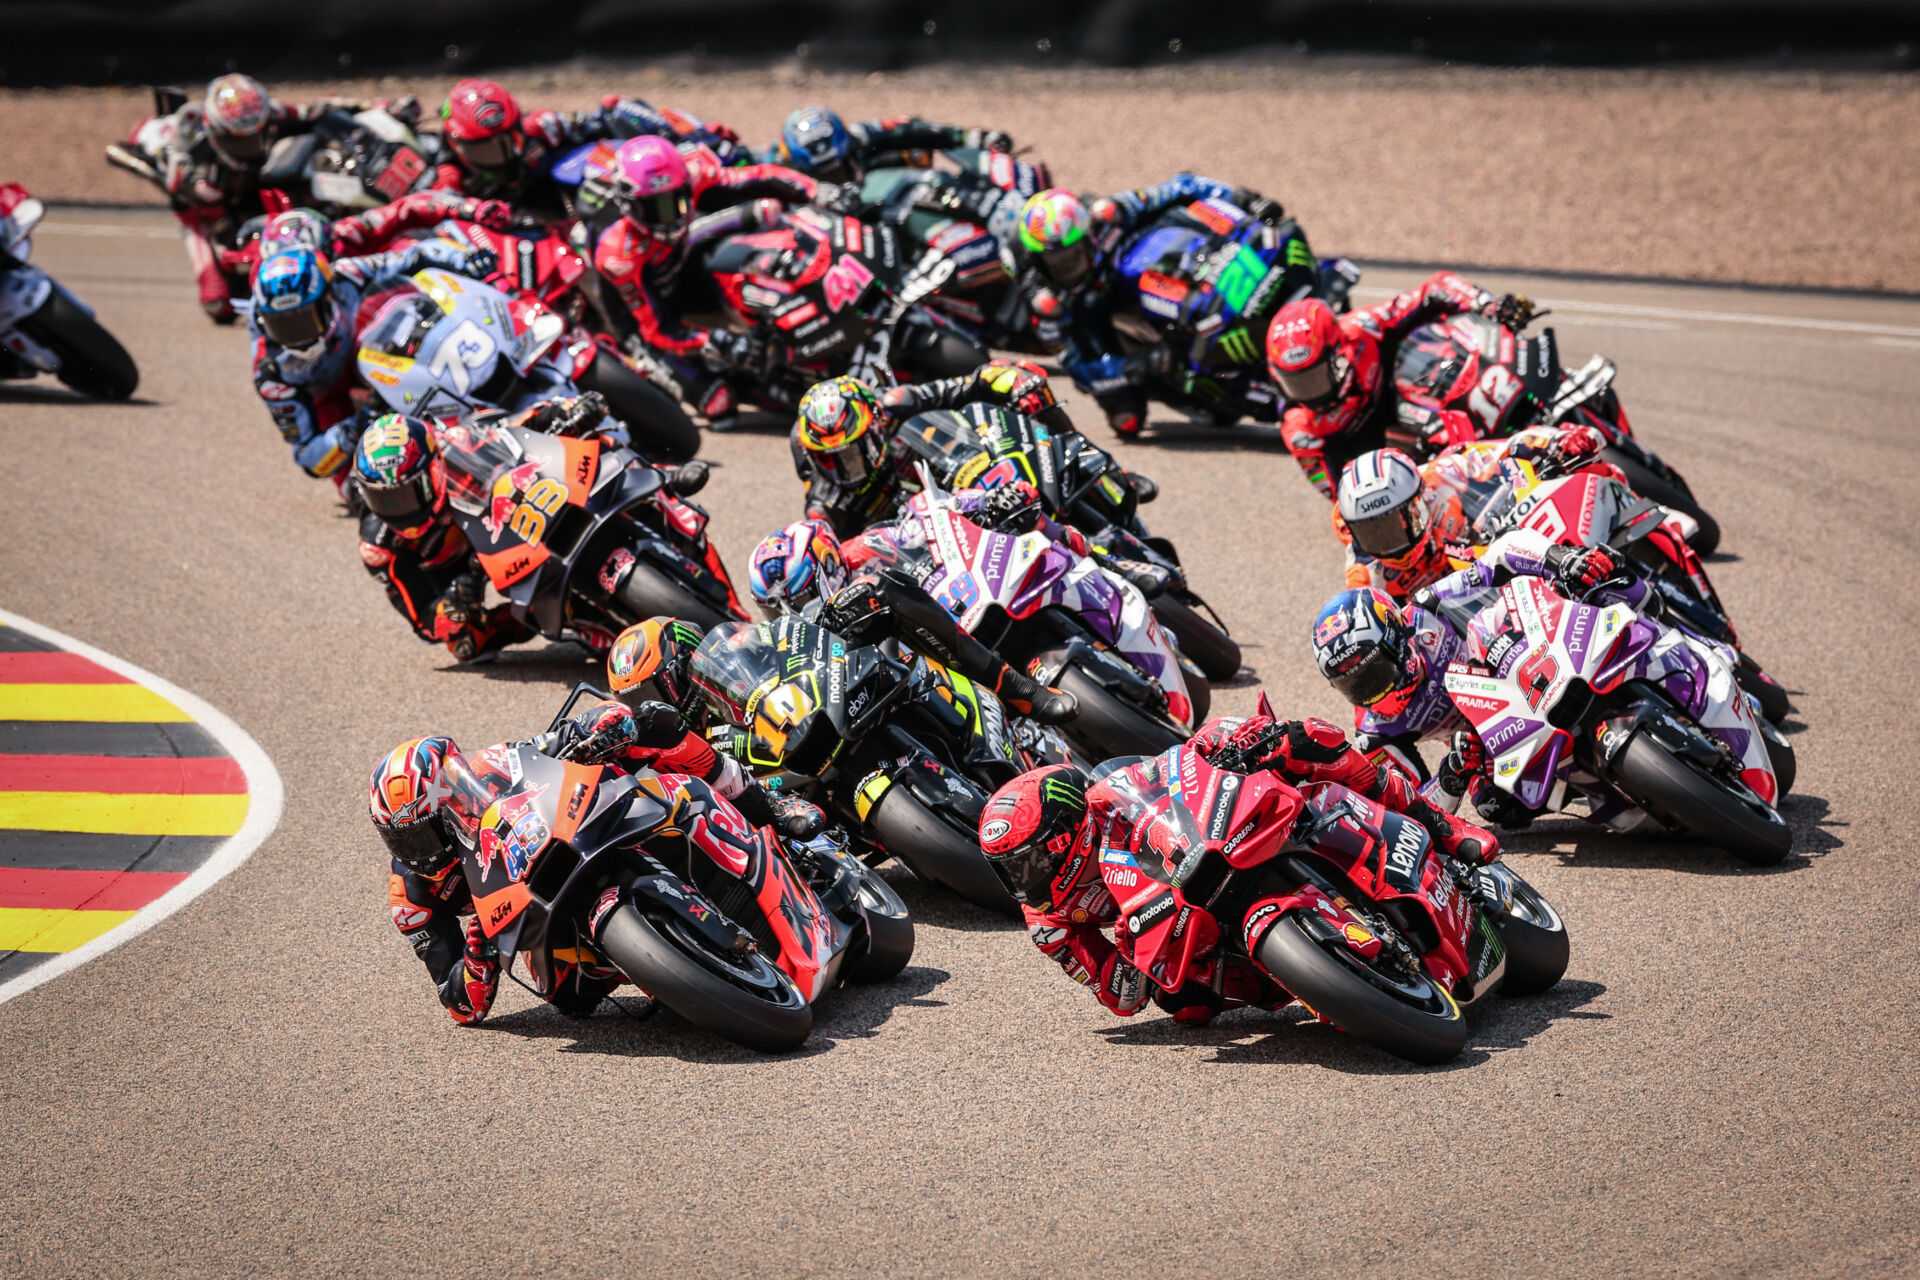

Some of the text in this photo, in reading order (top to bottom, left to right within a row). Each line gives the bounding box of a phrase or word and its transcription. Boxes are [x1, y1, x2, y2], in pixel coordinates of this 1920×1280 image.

[1468, 364, 1523, 433] 12
[578, 456, 591, 484] KTM
[1361, 495, 1391, 513] SHOEI
[1581, 476, 1599, 536] HONDA
[505, 558, 530, 579] KTM
[986, 535, 1007, 580] prima
[1569, 606, 1591, 654] prima
[1328, 643, 1361, 668] SHARK
[1486, 634, 1514, 668] FIAMM
[1500, 643, 1524, 677] prima
[830, 642, 846, 704] mooneygo
[849, 687, 869, 717] ebay
[1456, 695, 1498, 711] PRAMAC
[755, 683, 813, 758] 10
[1485, 718, 1526, 755] prima
[567, 783, 589, 821] KTM
[1211, 792, 1231, 839] motorola
[501, 811, 551, 882] 43
[1223, 822, 1255, 854] CARRERA
[1385, 820, 1423, 878] Lenovo
[1060, 858, 1081, 889] Lenovo
[490, 901, 512, 927] KTM
[1140, 896, 1174, 923] motorola
[1173, 908, 1190, 937] CARRERA
[1111, 963, 1123, 994] Lenovo
